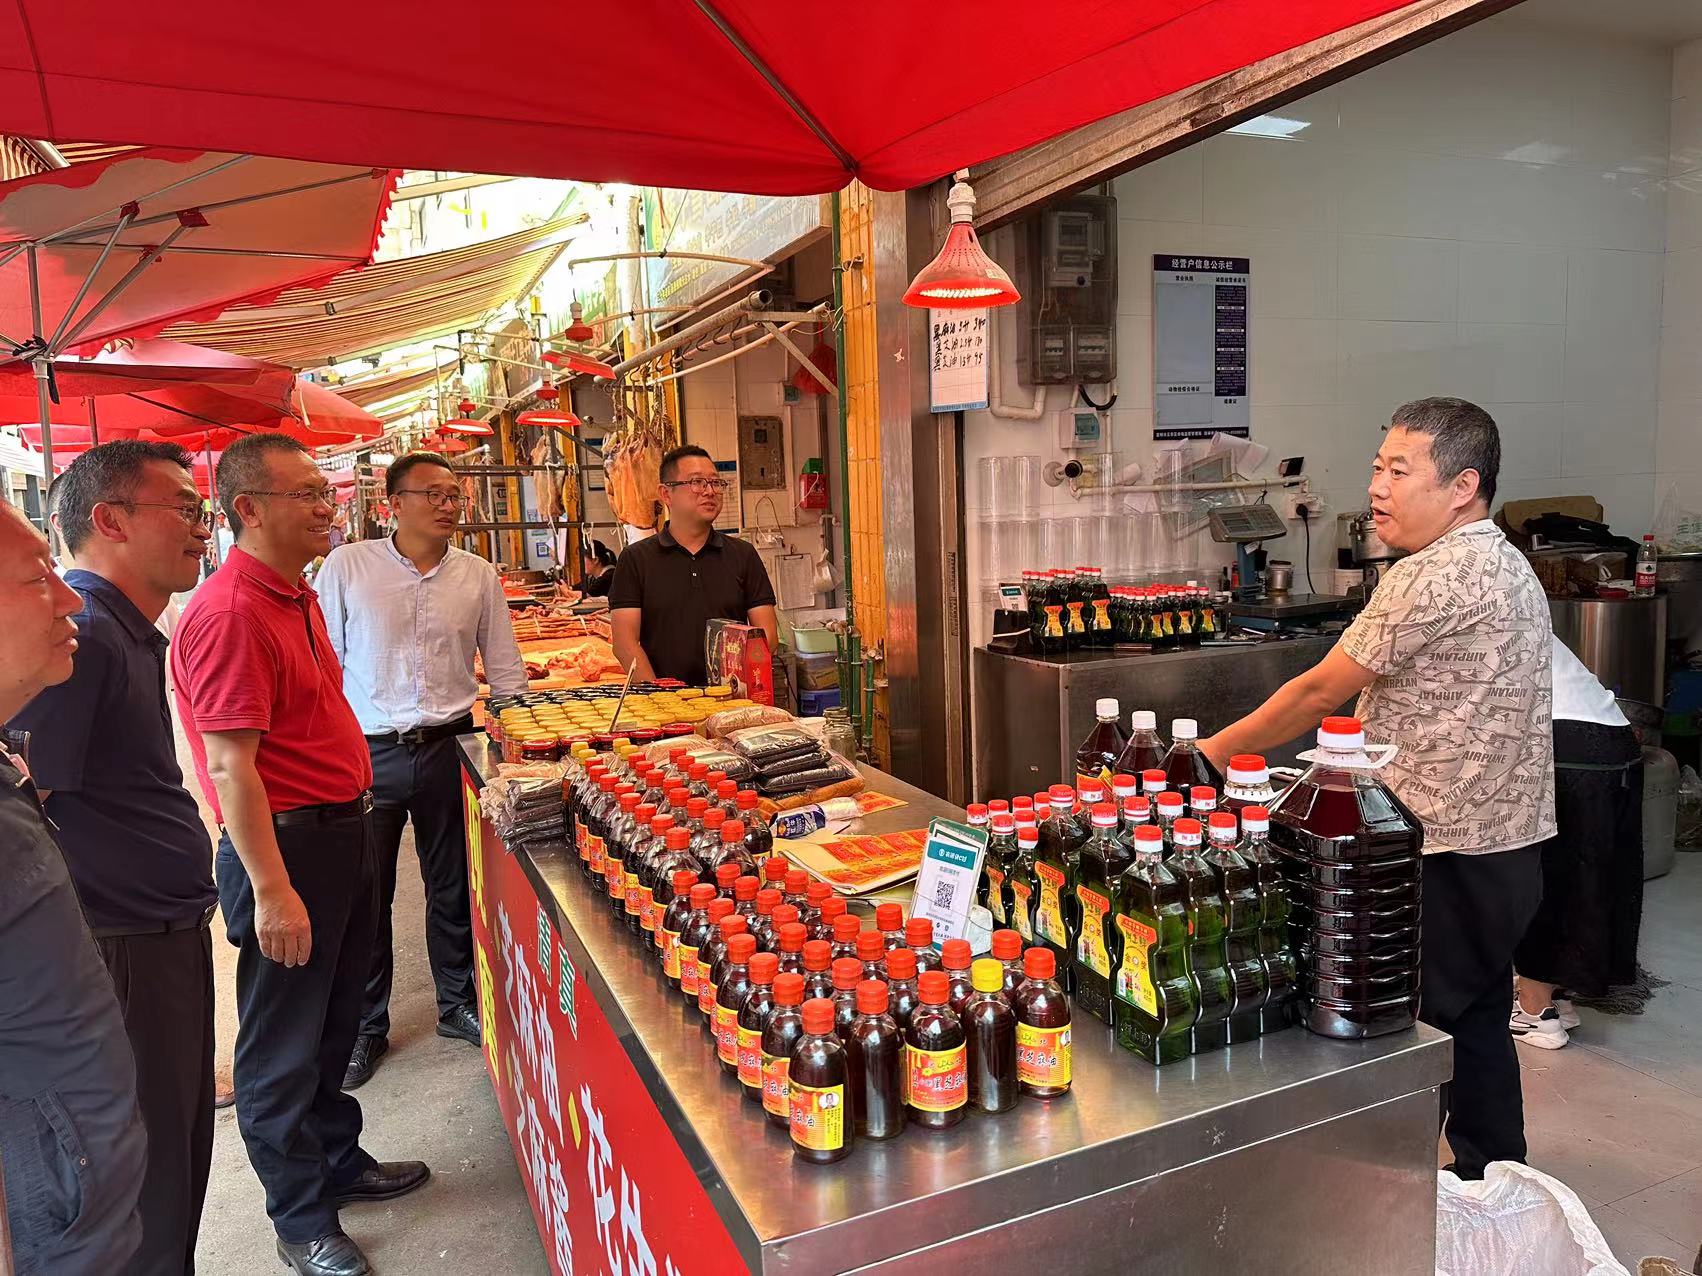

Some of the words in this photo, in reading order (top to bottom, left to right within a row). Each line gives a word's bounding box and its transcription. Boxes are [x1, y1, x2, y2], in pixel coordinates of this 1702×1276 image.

[1171, 258, 1233, 271] 经营户信息公示栏
[1455, 547, 1479, 587] AIRPLANE
[1429, 651, 1488, 663] AIRPLANE
[1463, 750, 1507, 765] AIRPLANE
[1440, 771, 1482, 807] AIRPLANE
[536, 900, 578, 1040] 清真
[498, 900, 564, 1150] 芝麻油
[580, 1082, 683, 1276] 花生
